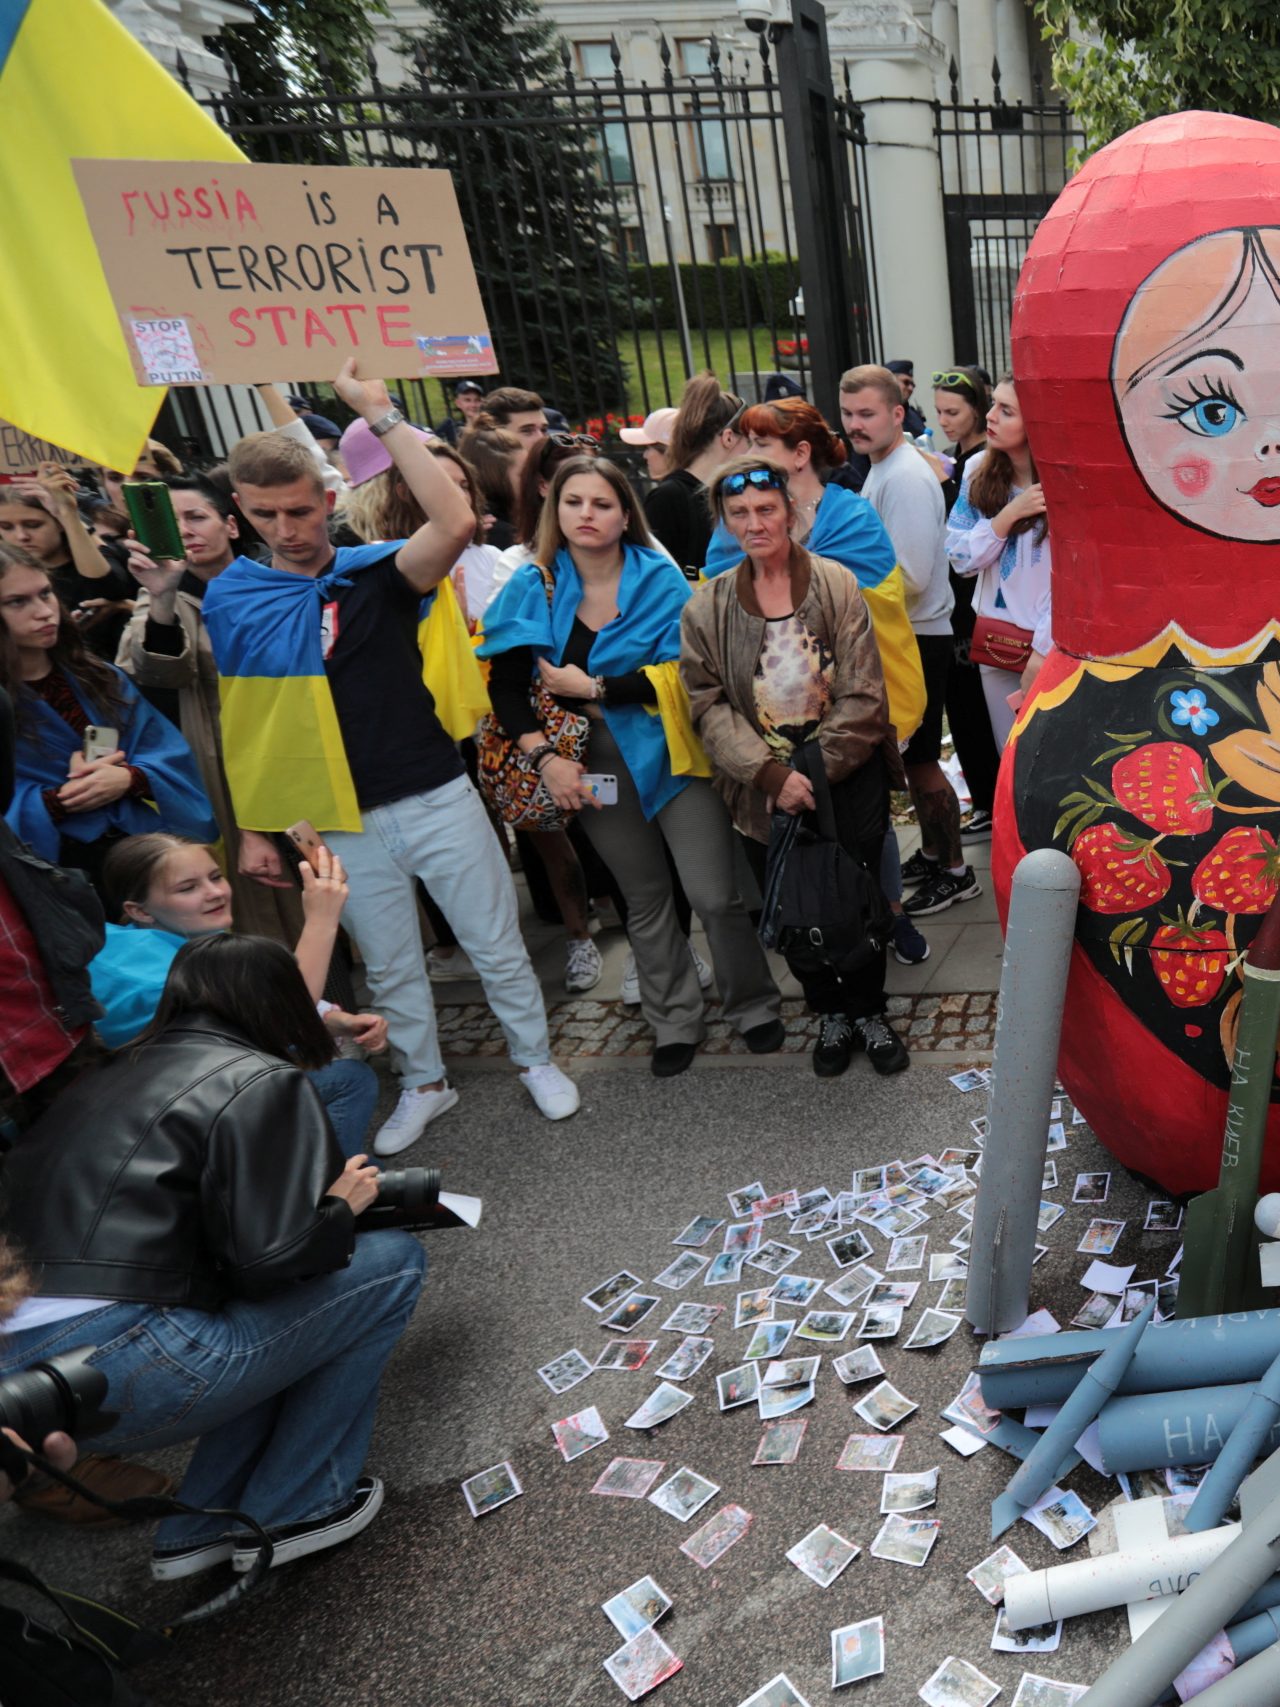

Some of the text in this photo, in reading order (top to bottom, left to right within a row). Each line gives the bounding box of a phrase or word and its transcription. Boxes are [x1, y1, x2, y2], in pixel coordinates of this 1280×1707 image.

[377, 192, 399, 226] A
[135, 320, 183, 333] STOP
[229, 304, 415, 348] STATE
[148, 370, 203, 383] PUTIN
[1221, 1047, 1251, 1168] НА КИЕВ
[1163, 1412, 1225, 1459] НА
